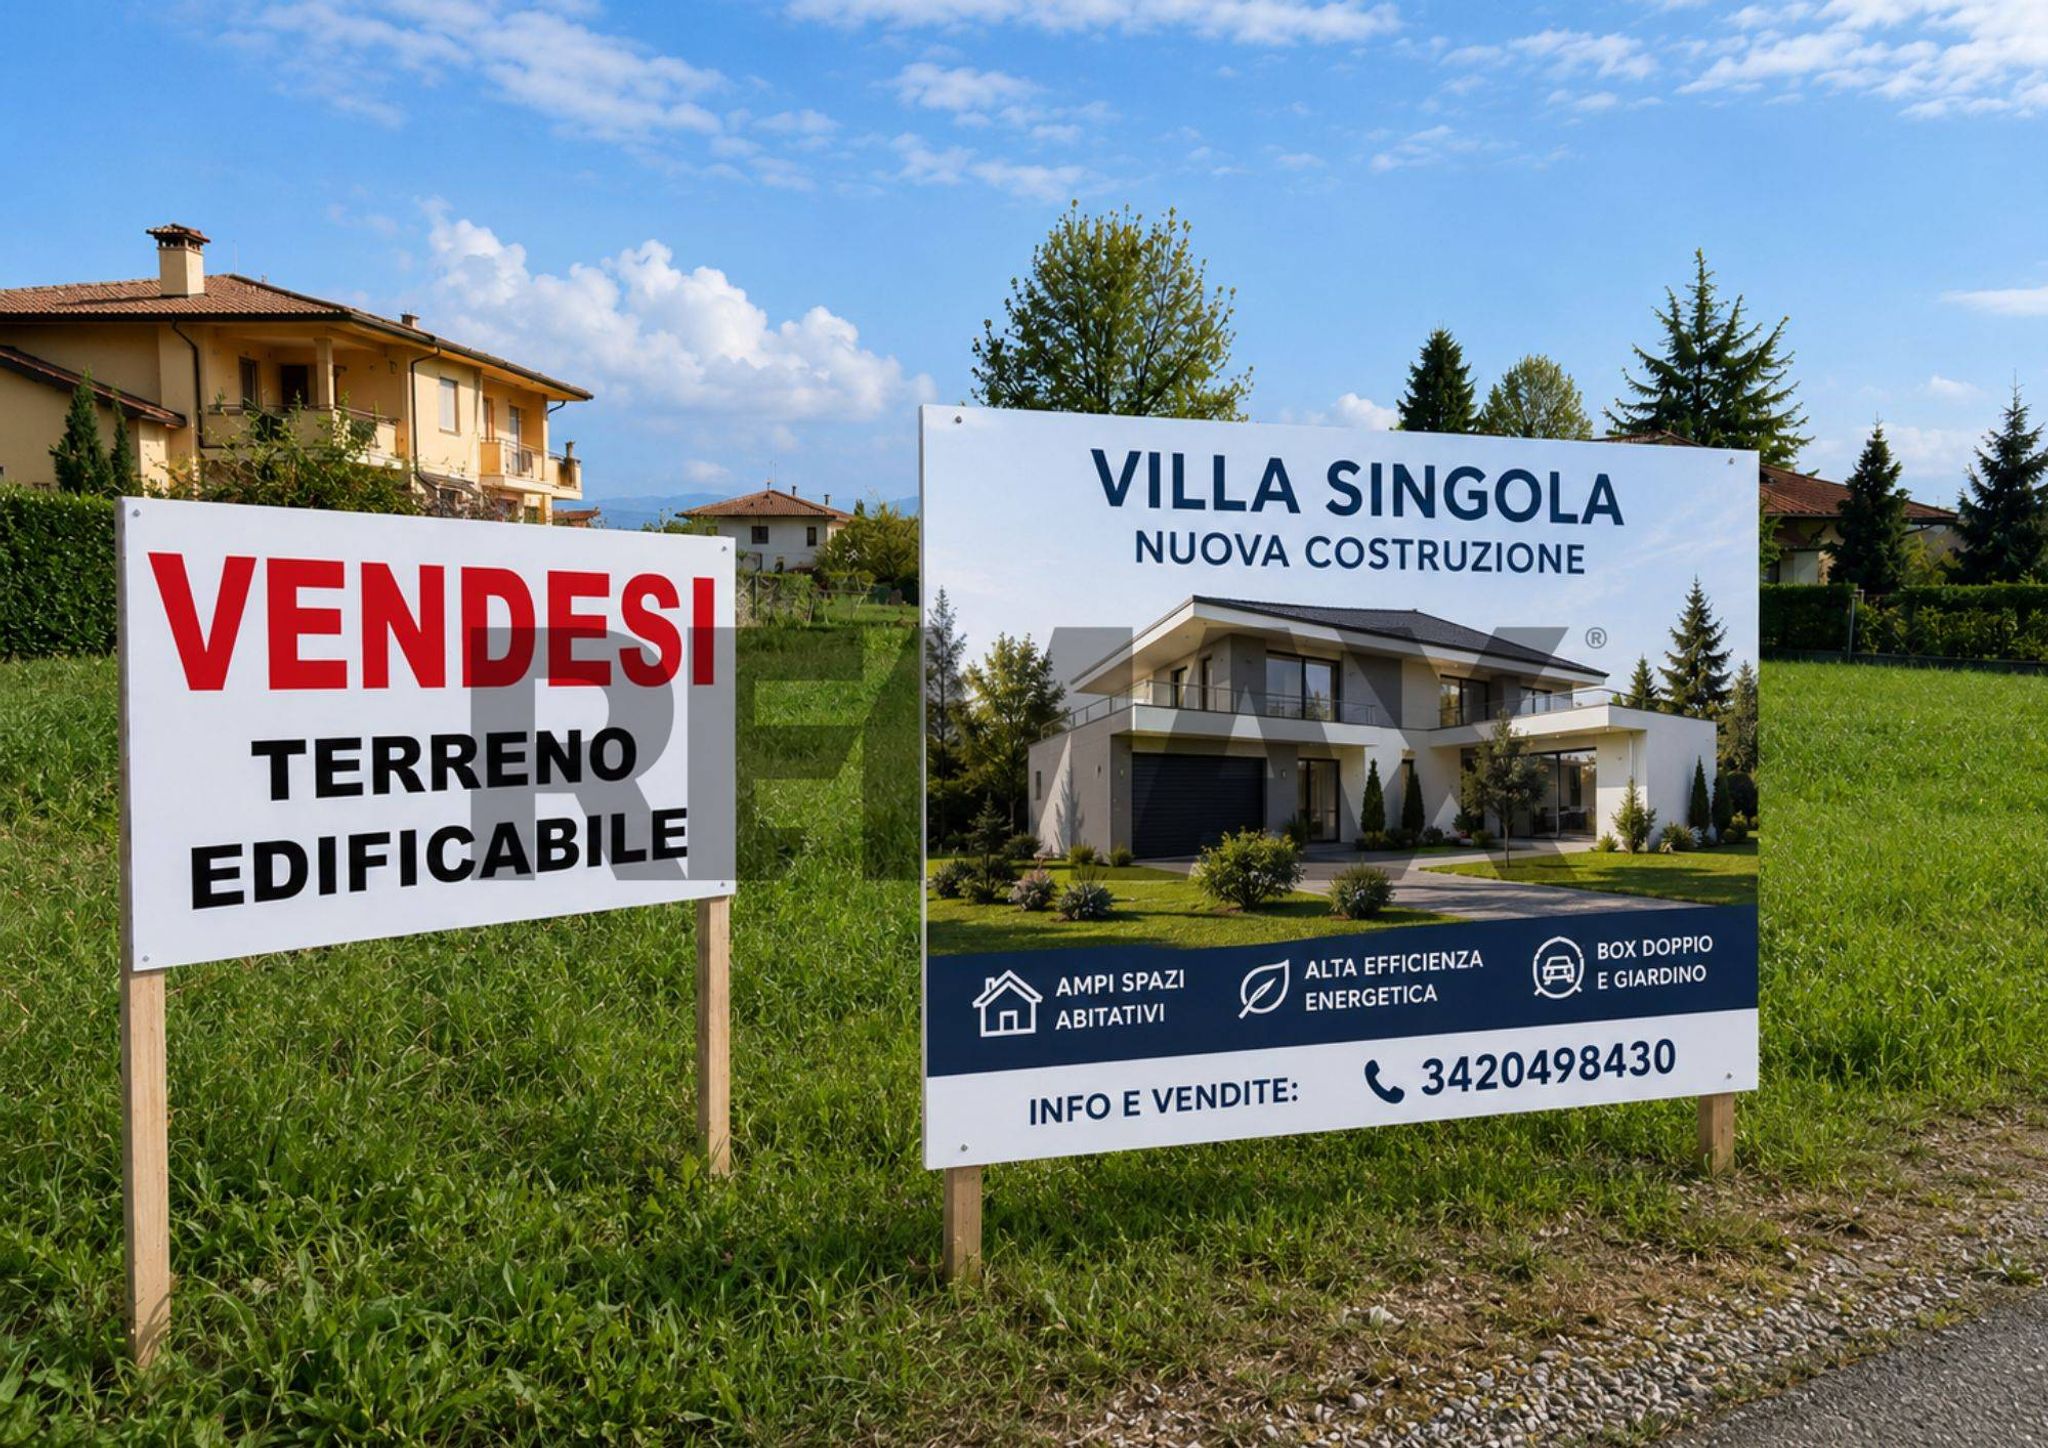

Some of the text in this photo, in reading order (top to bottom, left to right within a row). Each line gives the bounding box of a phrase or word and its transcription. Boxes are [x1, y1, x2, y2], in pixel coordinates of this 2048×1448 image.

[1090, 448, 1625, 526] VILLA SINGOLA
[1135, 530, 1585, 575] NUOVA COSTRUZIONE
[148, 551, 716, 692] VENDESI
[251, 726, 637, 801] TERRENO
[191, 808, 688, 910] EDIFICABILE
[1304, 949, 1484, 980] ALTA EFFICIENZA
[1597, 935, 1713, 961] BOX DOPPIO
[1055, 969, 1184, 997] AMPI SPAZI
[1305, 983, 1438, 1012] ENERGETICA
[1597, 964, 1707, 990] E GIARDINO
[1055, 1002, 1164, 1030] ABITATIVI
[1421, 1038, 1676, 1096] 3420498430
[1030, 1077, 1298, 1126] INFO E VENDITE:
